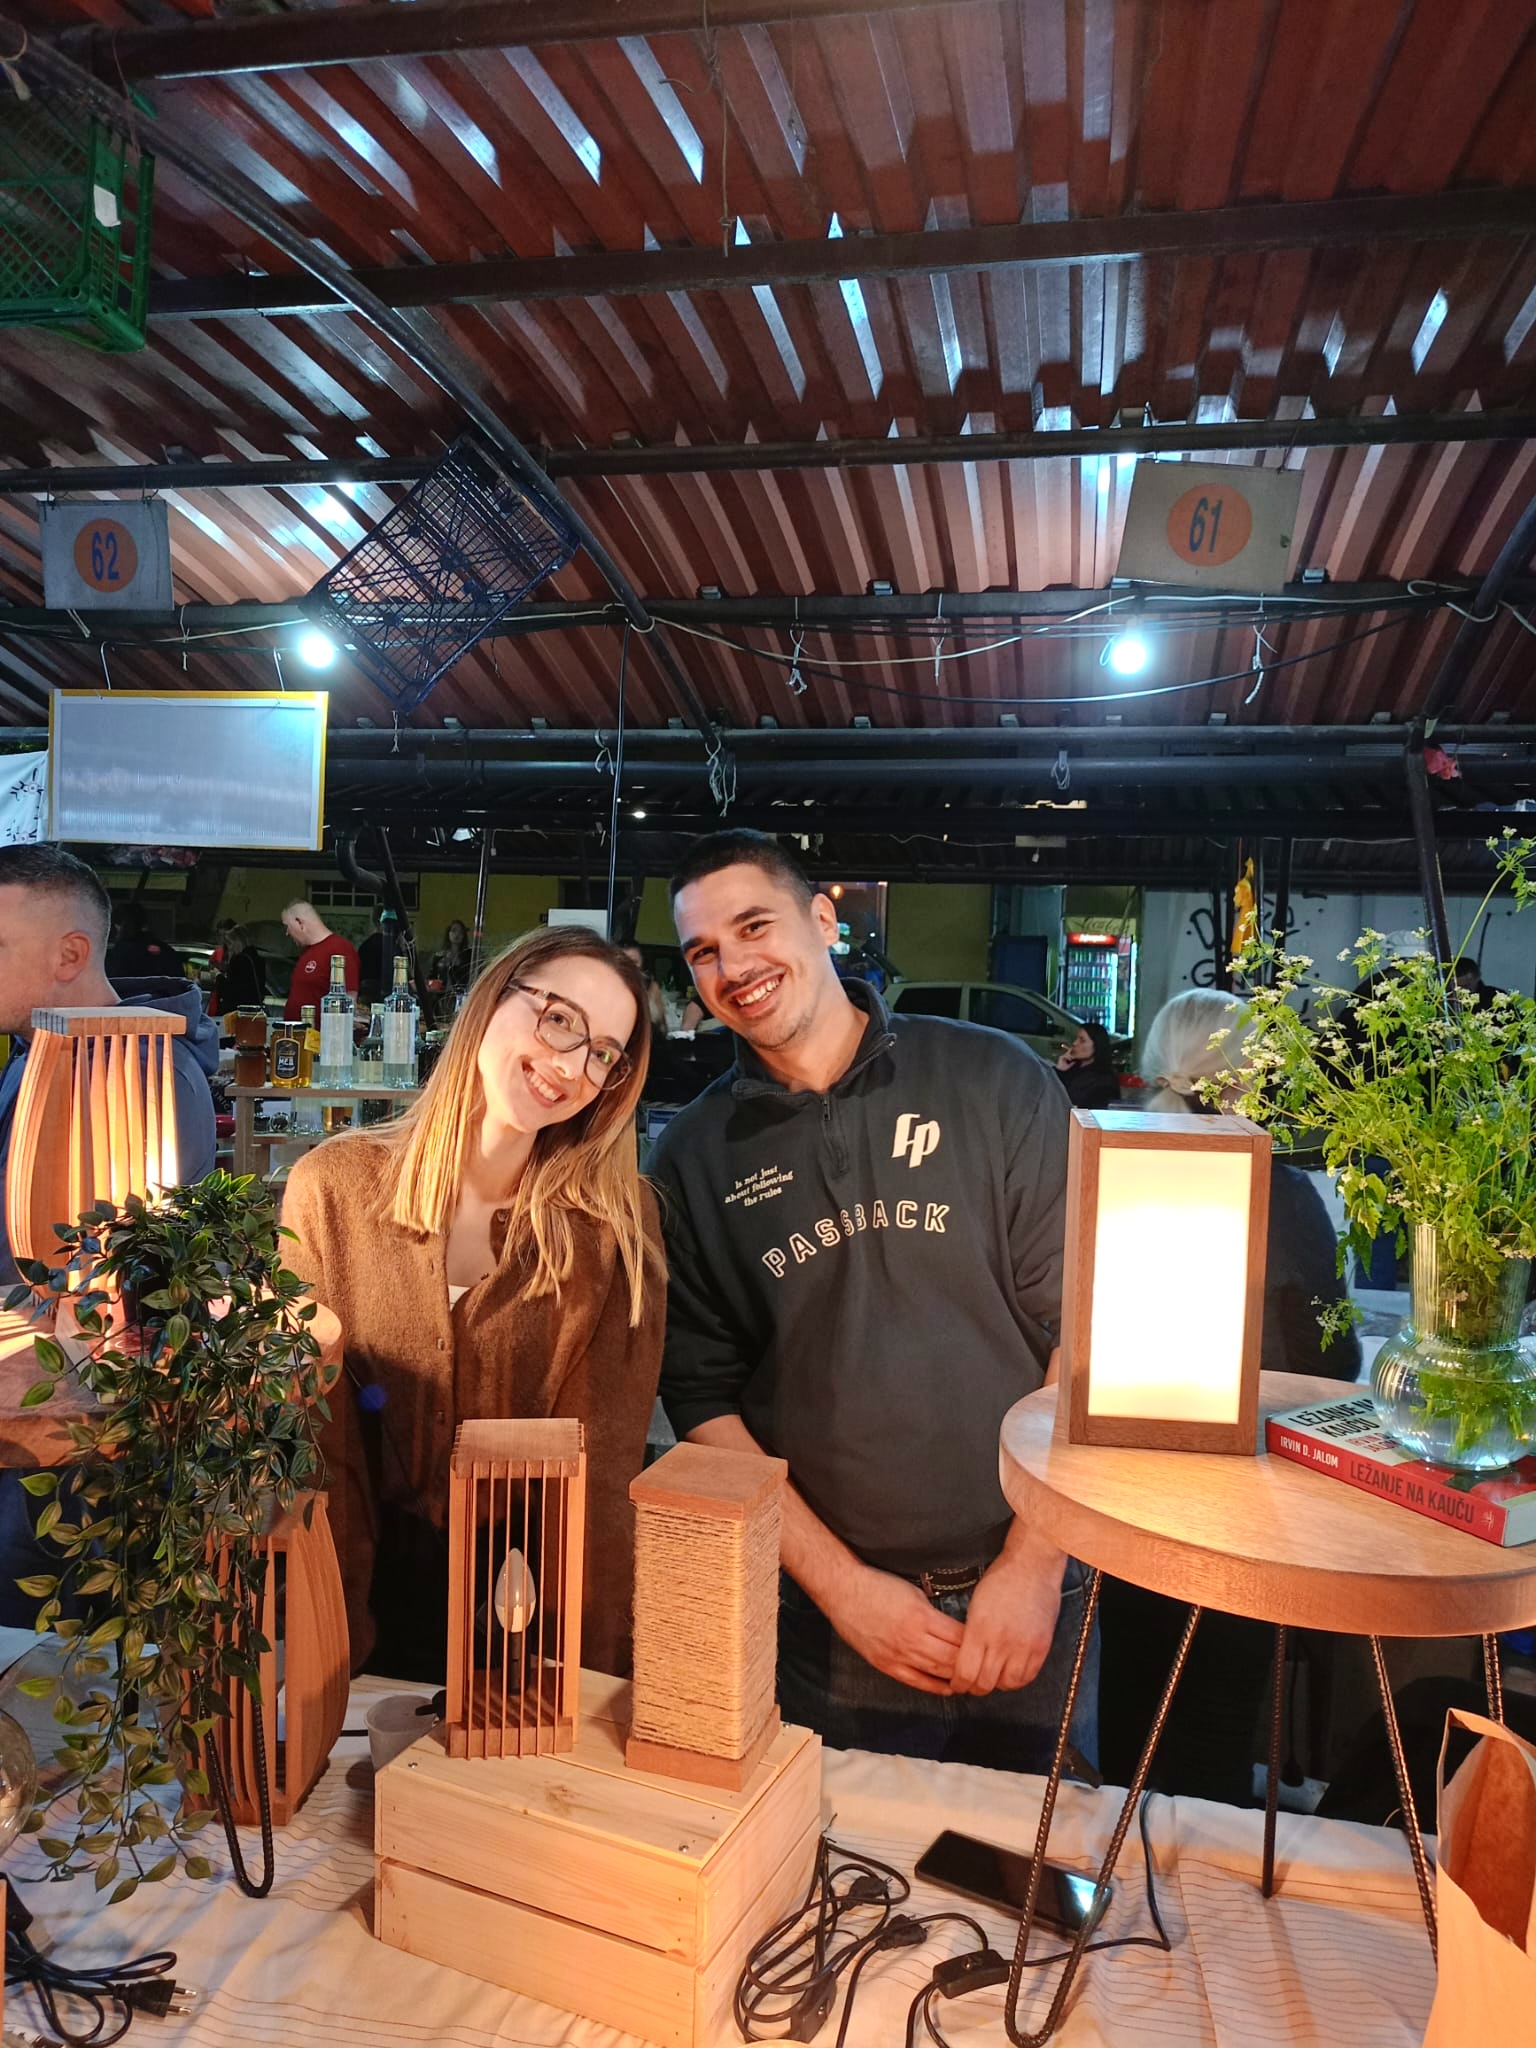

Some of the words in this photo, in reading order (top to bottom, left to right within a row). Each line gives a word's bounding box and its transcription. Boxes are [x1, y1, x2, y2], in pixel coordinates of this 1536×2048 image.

[1189, 497, 1223, 552] 61
[92, 531, 119, 580] 62
[725, 1186, 750, 1204] about
[752, 1170, 794, 1193] following
[744, 1172, 758, 1185] not
[744, 1196, 758, 1207] the
[759, 1186, 783, 1201] rules
[762, 1200, 949, 1278] PASSBACK
[1288, 1404, 1366, 1427] LEŽANJE
[1351, 1399, 1375, 1411] N
[1315, 1417, 1380, 1438] KAUČU
[1280, 1435, 1301, 1454] IRVIN
[1302, 1442, 1311, 1457] D.
[1312, 1447, 1339, 1468] JALOM
[1350, 1461, 1403, 1497] LEŽANJE
[1406, 1481, 1425, 1506] NA
[1427, 1488, 1475, 1524] KAUČU
